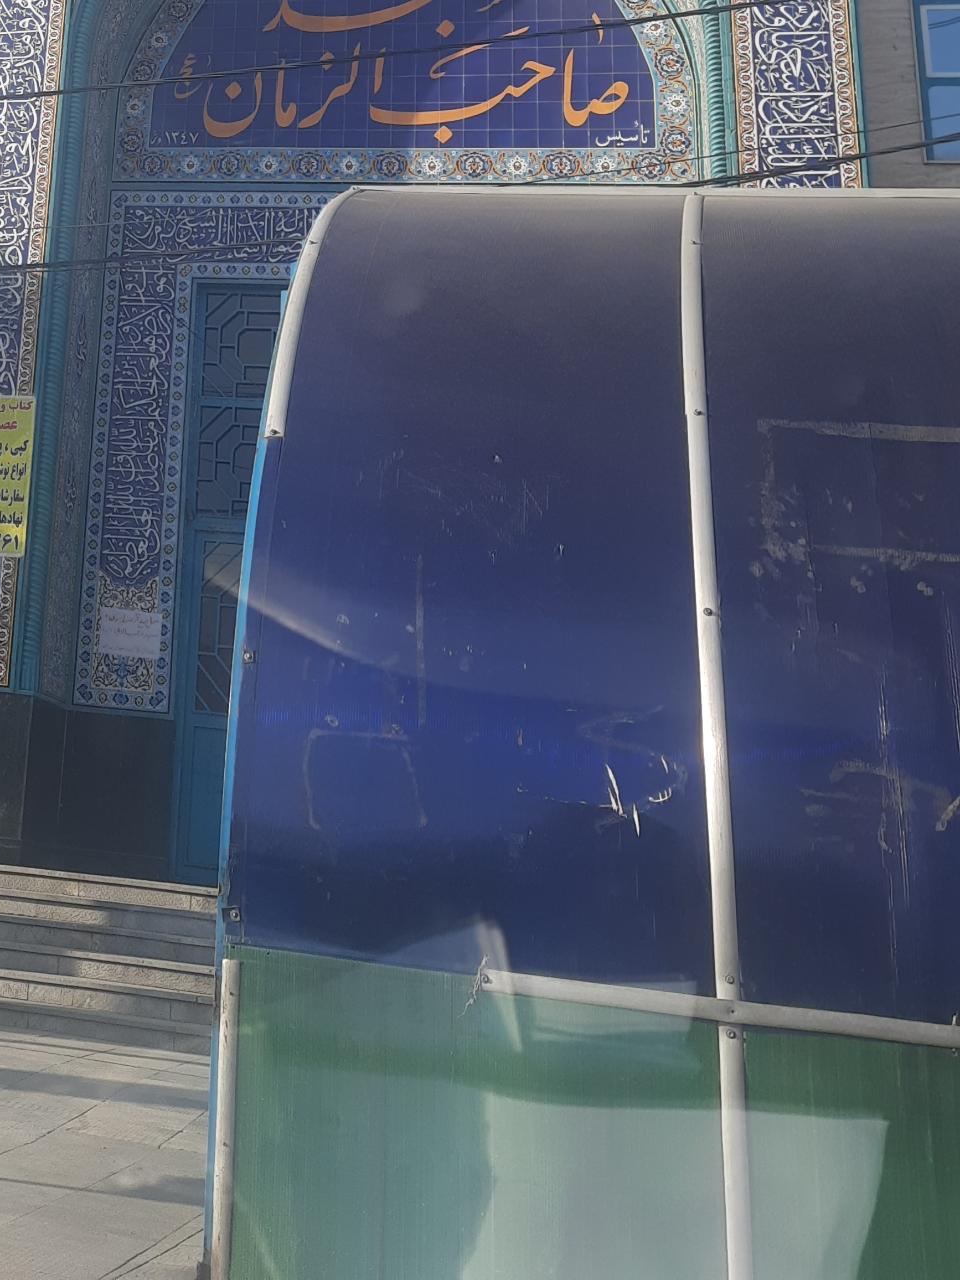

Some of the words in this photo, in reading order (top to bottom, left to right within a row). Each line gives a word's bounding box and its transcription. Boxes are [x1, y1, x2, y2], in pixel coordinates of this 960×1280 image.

[202, 40, 389, 138] الزمان
[368, 46, 630, 144] صاحب
[9, 400, 35, 412] کتاب
